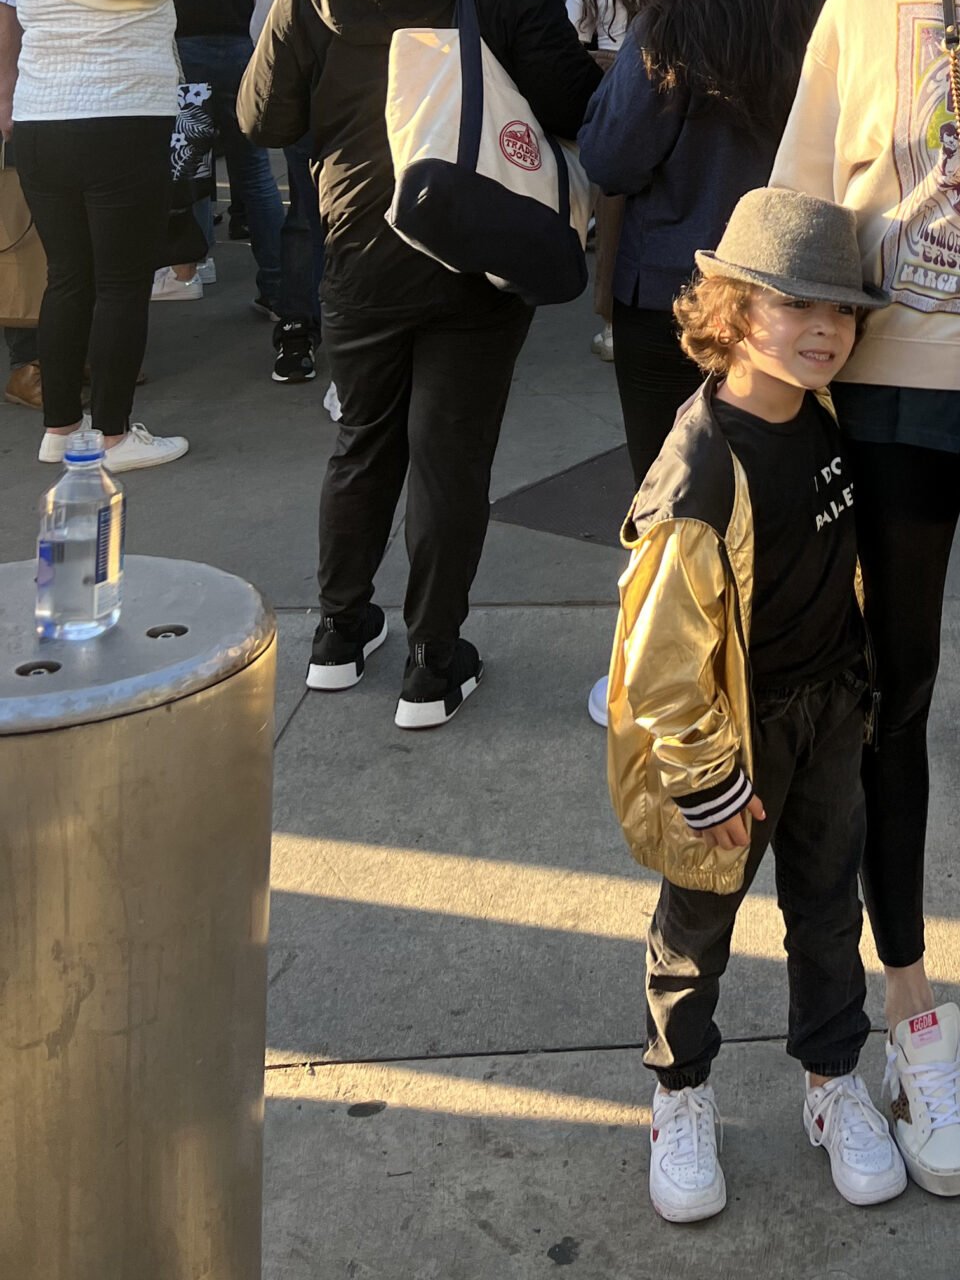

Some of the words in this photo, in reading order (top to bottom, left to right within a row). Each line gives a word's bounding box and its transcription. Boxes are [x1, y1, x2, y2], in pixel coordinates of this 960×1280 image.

[504, 138, 539, 161] TRADER
[509, 149, 536, 166] JOE'S
[900, 263, 959, 293] MARCH
[912, 1013, 934, 1032] GGDB
